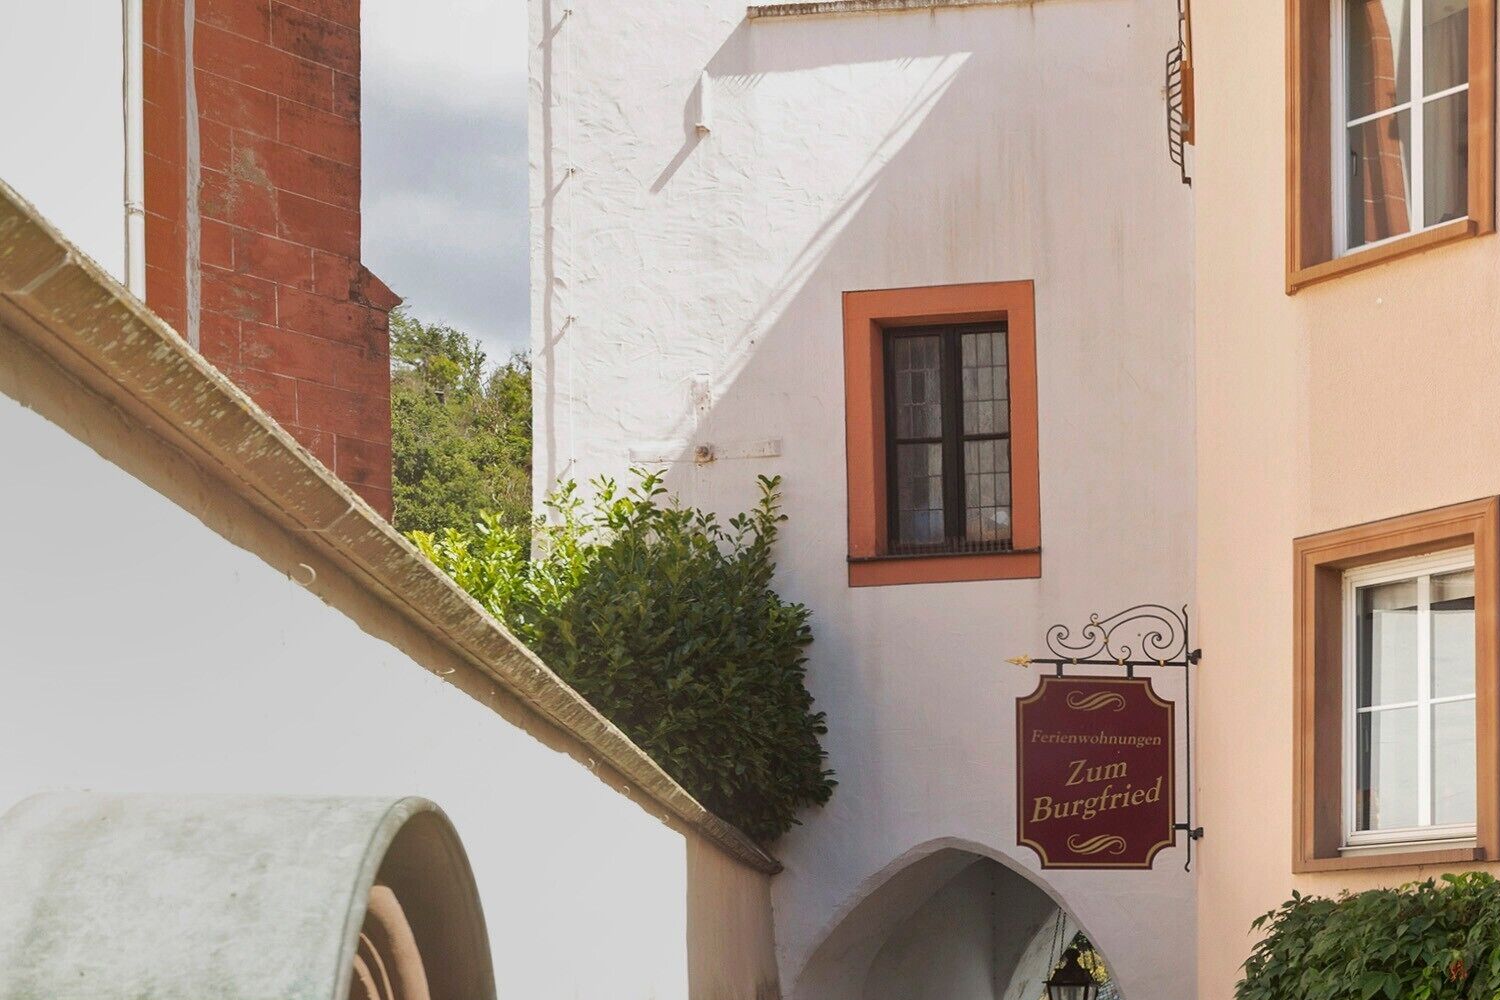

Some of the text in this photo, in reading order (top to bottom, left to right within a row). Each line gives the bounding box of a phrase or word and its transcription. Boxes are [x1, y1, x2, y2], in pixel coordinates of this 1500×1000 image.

[1031, 729, 1162, 748] Ferienwohnungen
[1064, 759, 1128, 787] Zum
[1029, 775, 1163, 823] Burgfried
